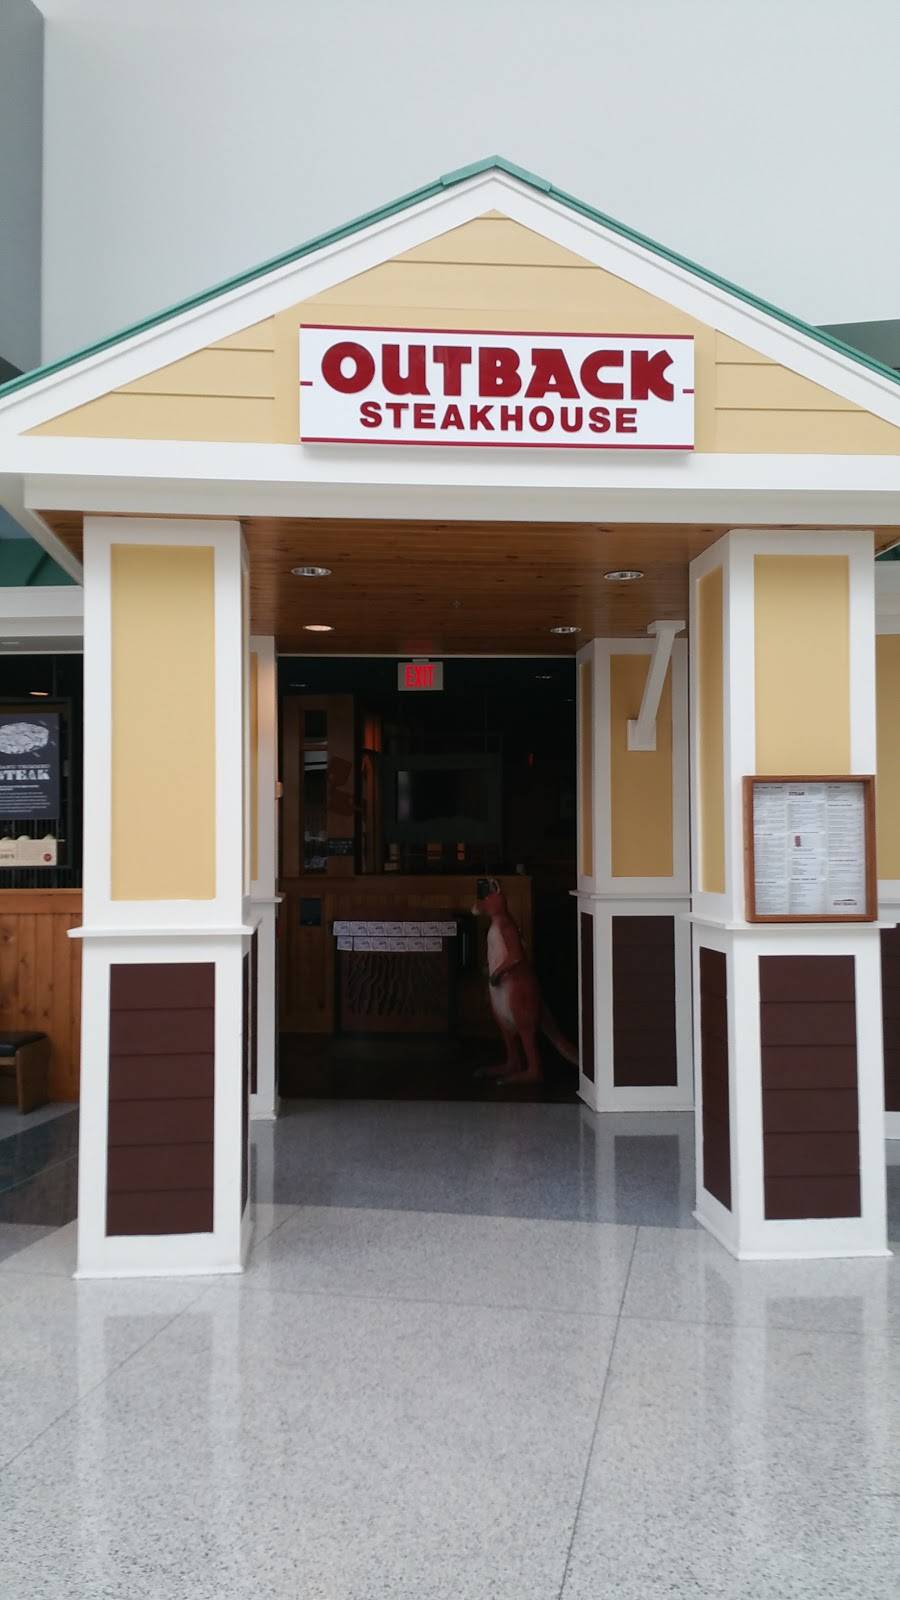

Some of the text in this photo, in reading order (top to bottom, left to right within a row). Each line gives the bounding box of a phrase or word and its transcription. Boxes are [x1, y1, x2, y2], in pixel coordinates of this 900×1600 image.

[321, 341, 674, 402] OUTBACK
[359, 401, 637, 433] STEAKHOUSE
[405, 663, 434, 689] EXIT
